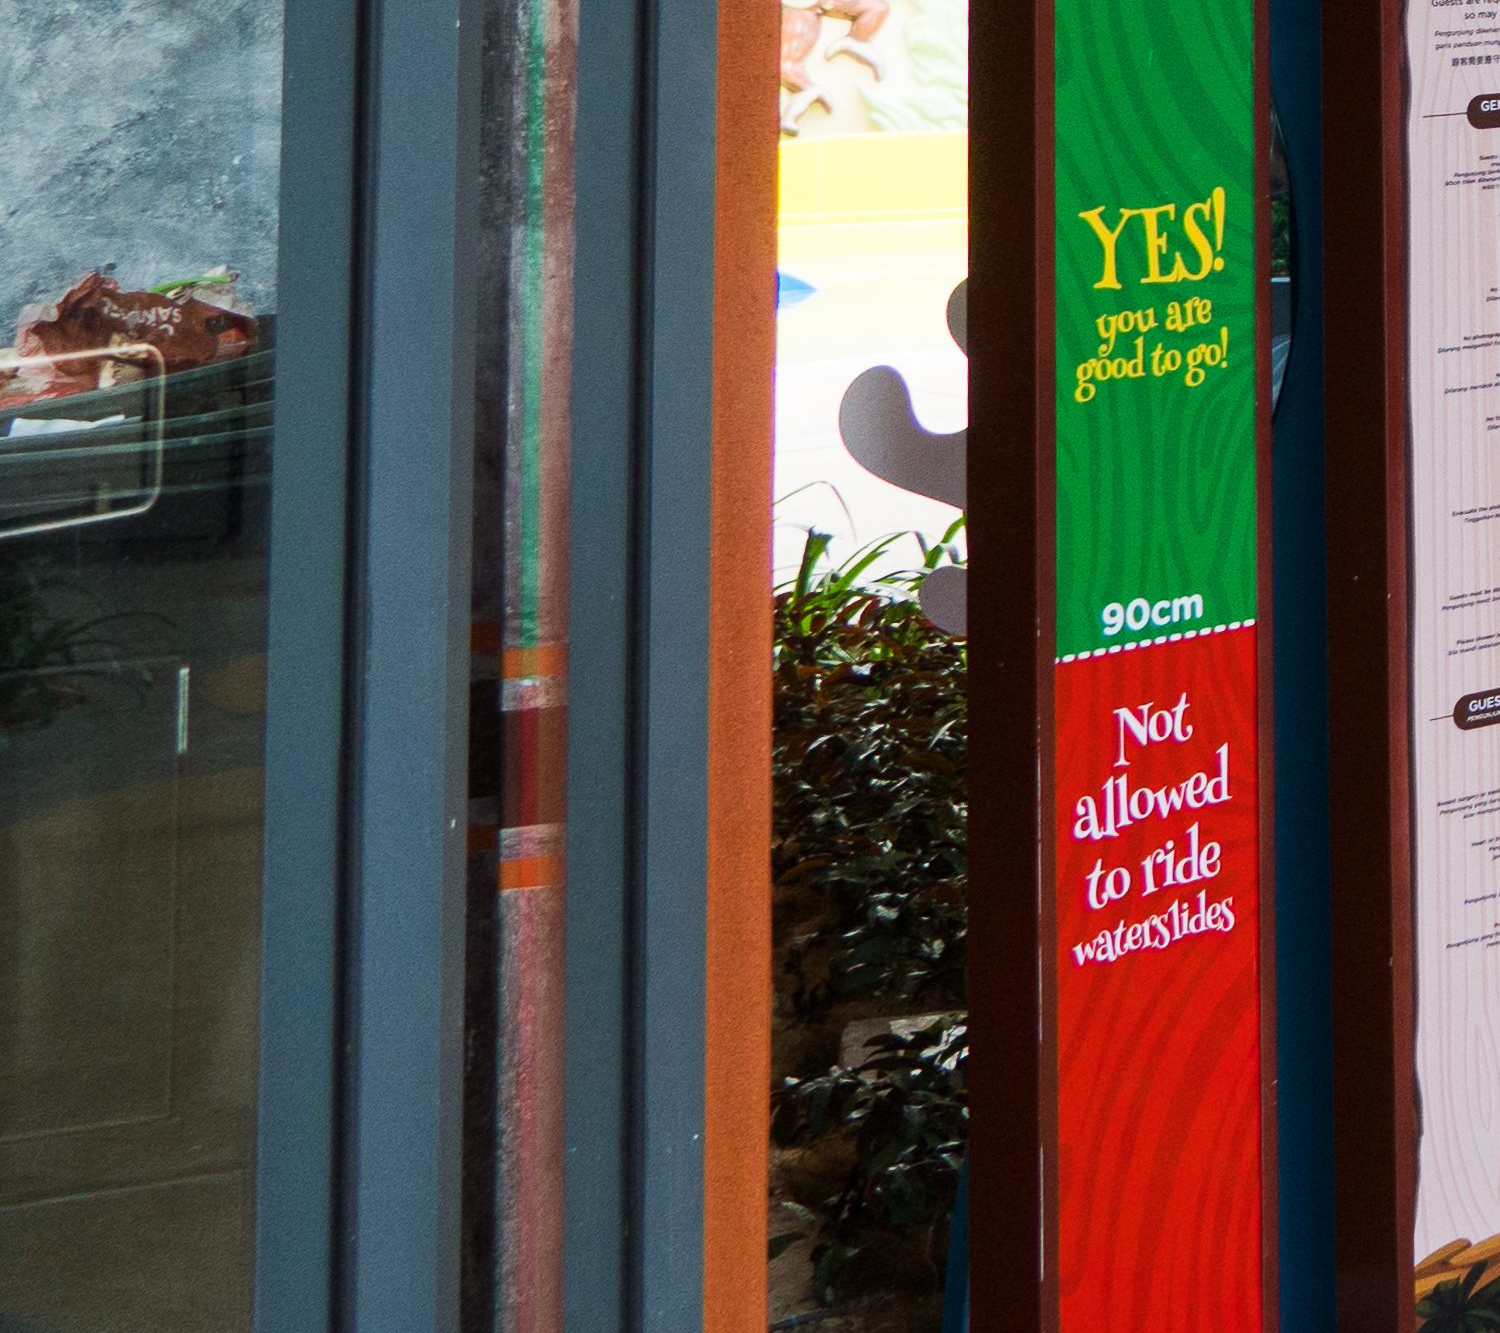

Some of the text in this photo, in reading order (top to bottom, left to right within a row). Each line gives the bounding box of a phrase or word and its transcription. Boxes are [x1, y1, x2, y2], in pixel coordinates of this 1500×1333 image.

[1477, 10, 1497, 20] may
[1079, 186, 1226, 289] YES!
[1074, 326, 1228, 403] good to go!
[1096, 296, 1212, 357] you are
[1101, 591, 1204, 636] 90cm
[1113, 691, 1194, 767] Not
[1073, 742, 1233, 841] allowed
[1085, 822, 1222, 911] to ride
[1073, 893, 1236, 967] waterslides
